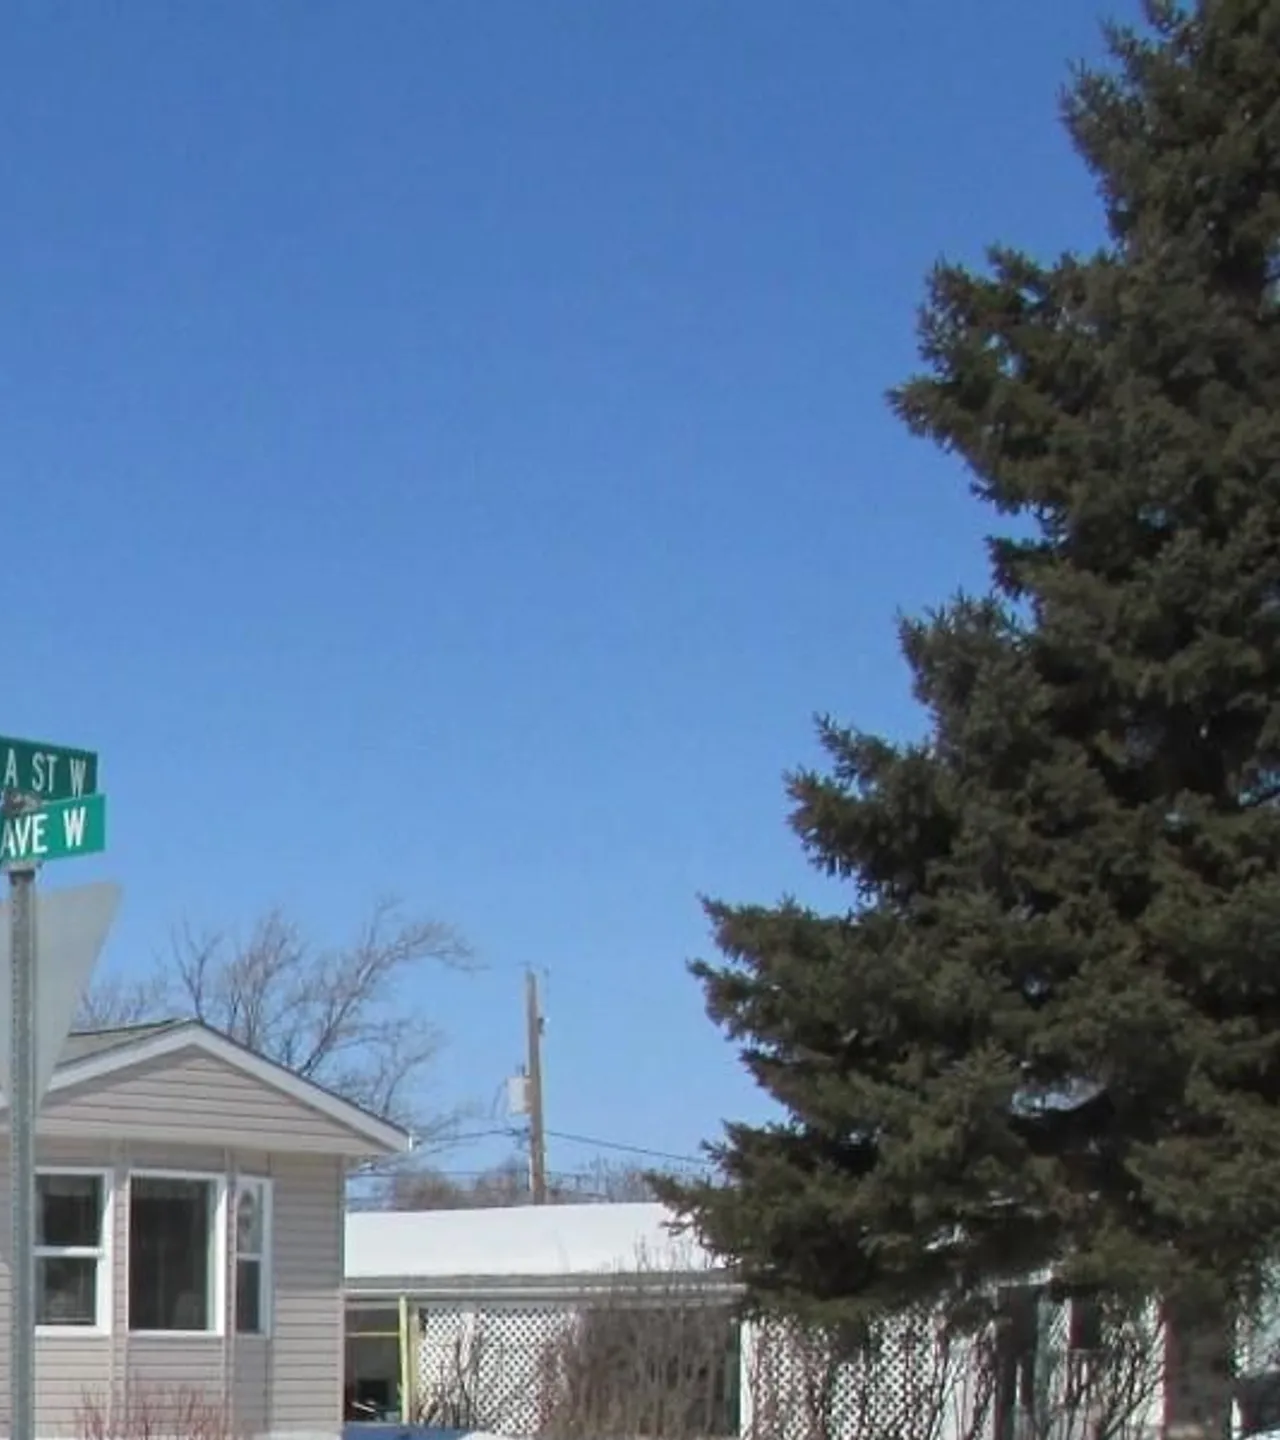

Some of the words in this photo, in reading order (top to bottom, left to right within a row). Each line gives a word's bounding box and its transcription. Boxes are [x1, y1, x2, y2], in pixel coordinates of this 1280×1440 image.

[4, 748, 19, 788] A
[32, 751, 58, 793] ST
[70, 758, 86, 799] W
[0, 813, 49, 859] AVE
[63, 806, 86, 849] W
